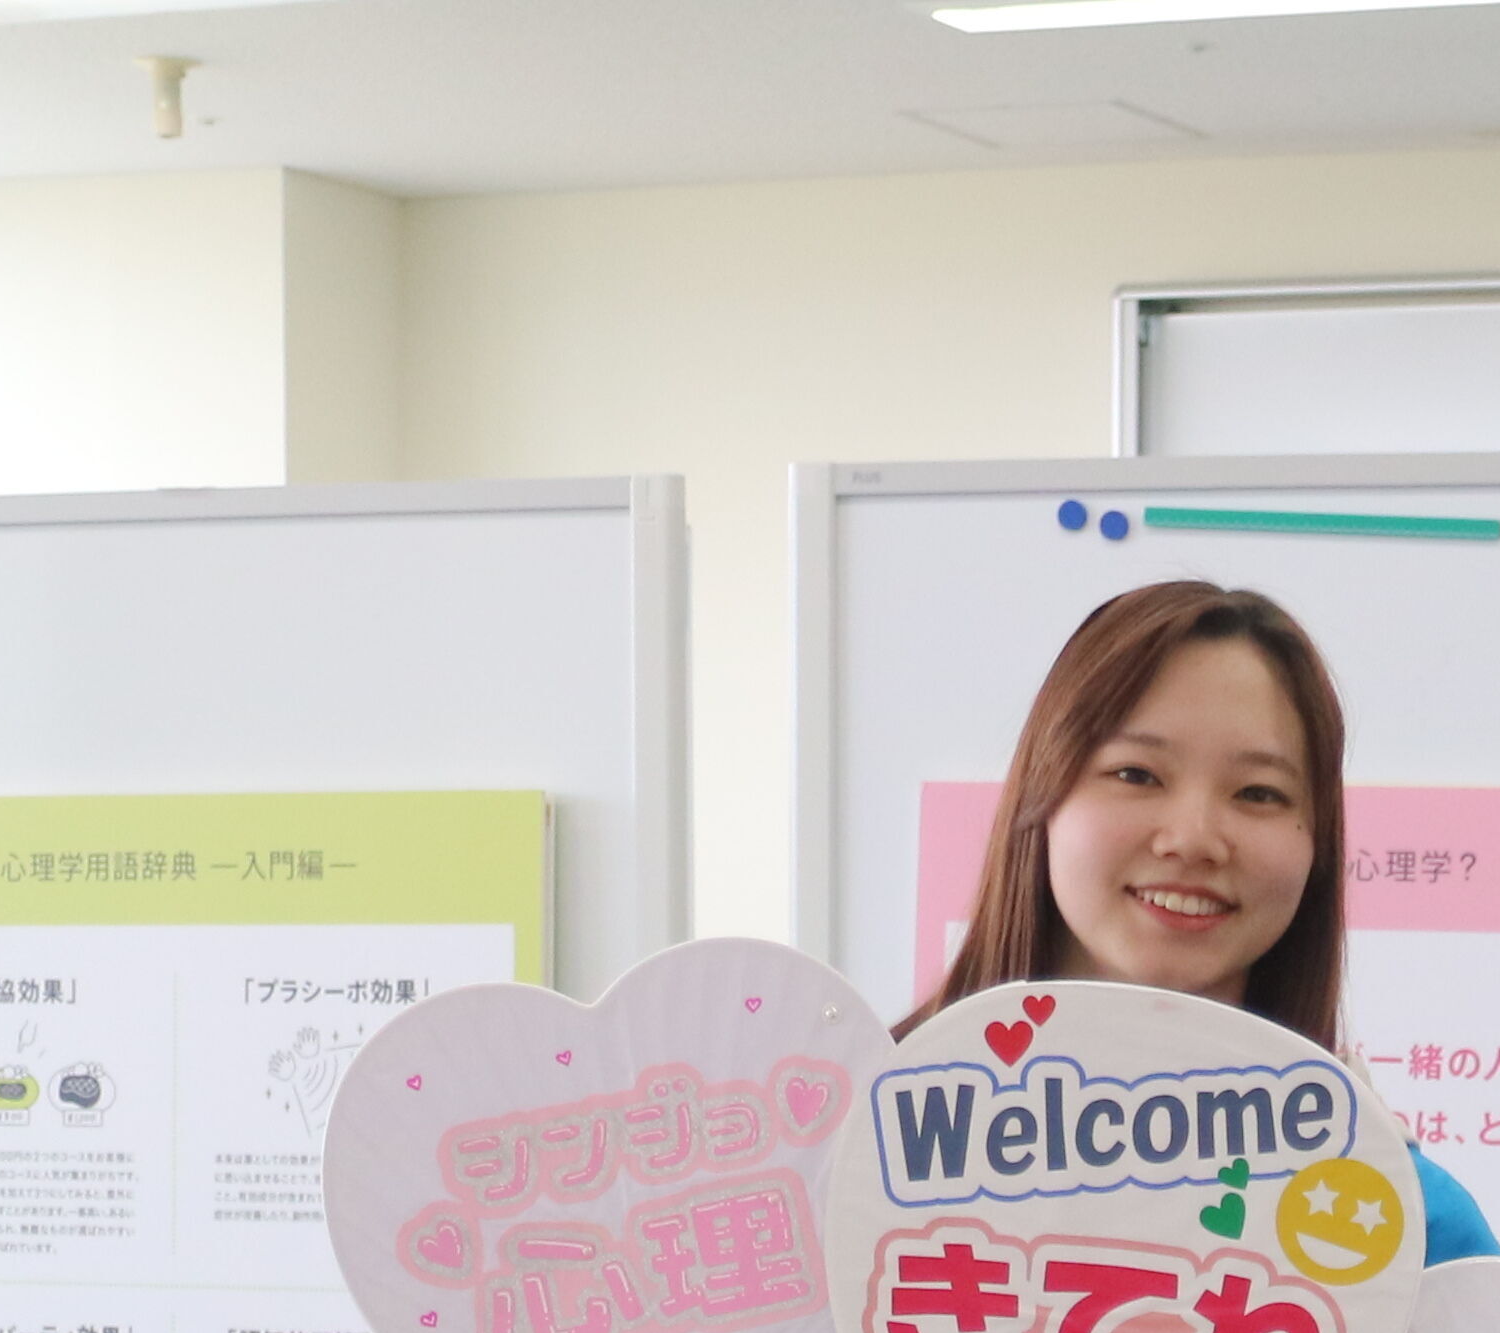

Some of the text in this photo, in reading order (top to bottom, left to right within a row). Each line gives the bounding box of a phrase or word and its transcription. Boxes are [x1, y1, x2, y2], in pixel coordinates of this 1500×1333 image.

[0, 851, 197, 882] 心理学用語辞典
[452, 1082, 762, 1196] シンジョ
[894, 1075, 1335, 1182] Welcome
